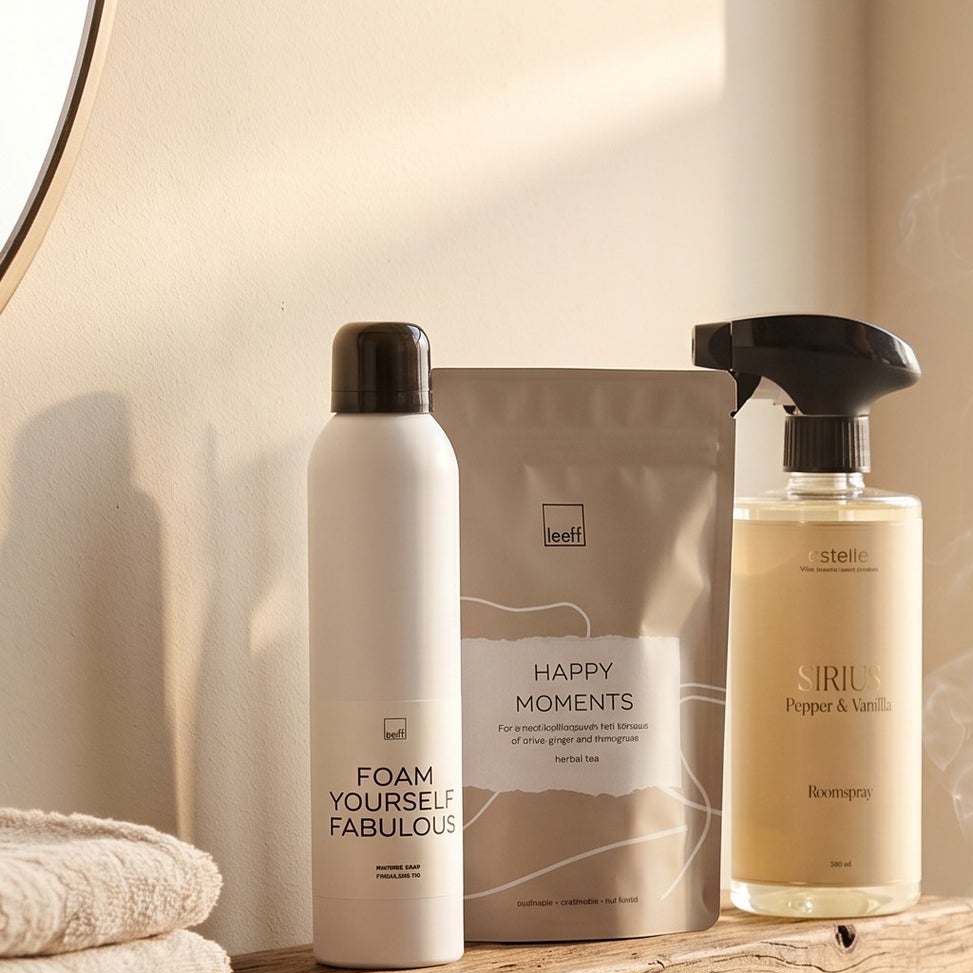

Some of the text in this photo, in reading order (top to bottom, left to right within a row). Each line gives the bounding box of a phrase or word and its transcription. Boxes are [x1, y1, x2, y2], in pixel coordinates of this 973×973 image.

[547, 526, 582, 543] leeff
[534, 662, 613, 681] HAPPY
[516, 693, 634, 712] MOMENTS
[786, 697, 833, 716] Pepper
[836, 698, 848, 712] &
[498, 724, 512, 732] For
[548, 736, 574, 746] ginger
[555, 755, 600, 763] herbal tea
[357, 766, 433, 787] FOAM
[329, 789, 455, 812] YOURSELF
[808, 785, 873, 802] Roomspray
[330, 814, 456, 838] FABULOUS
